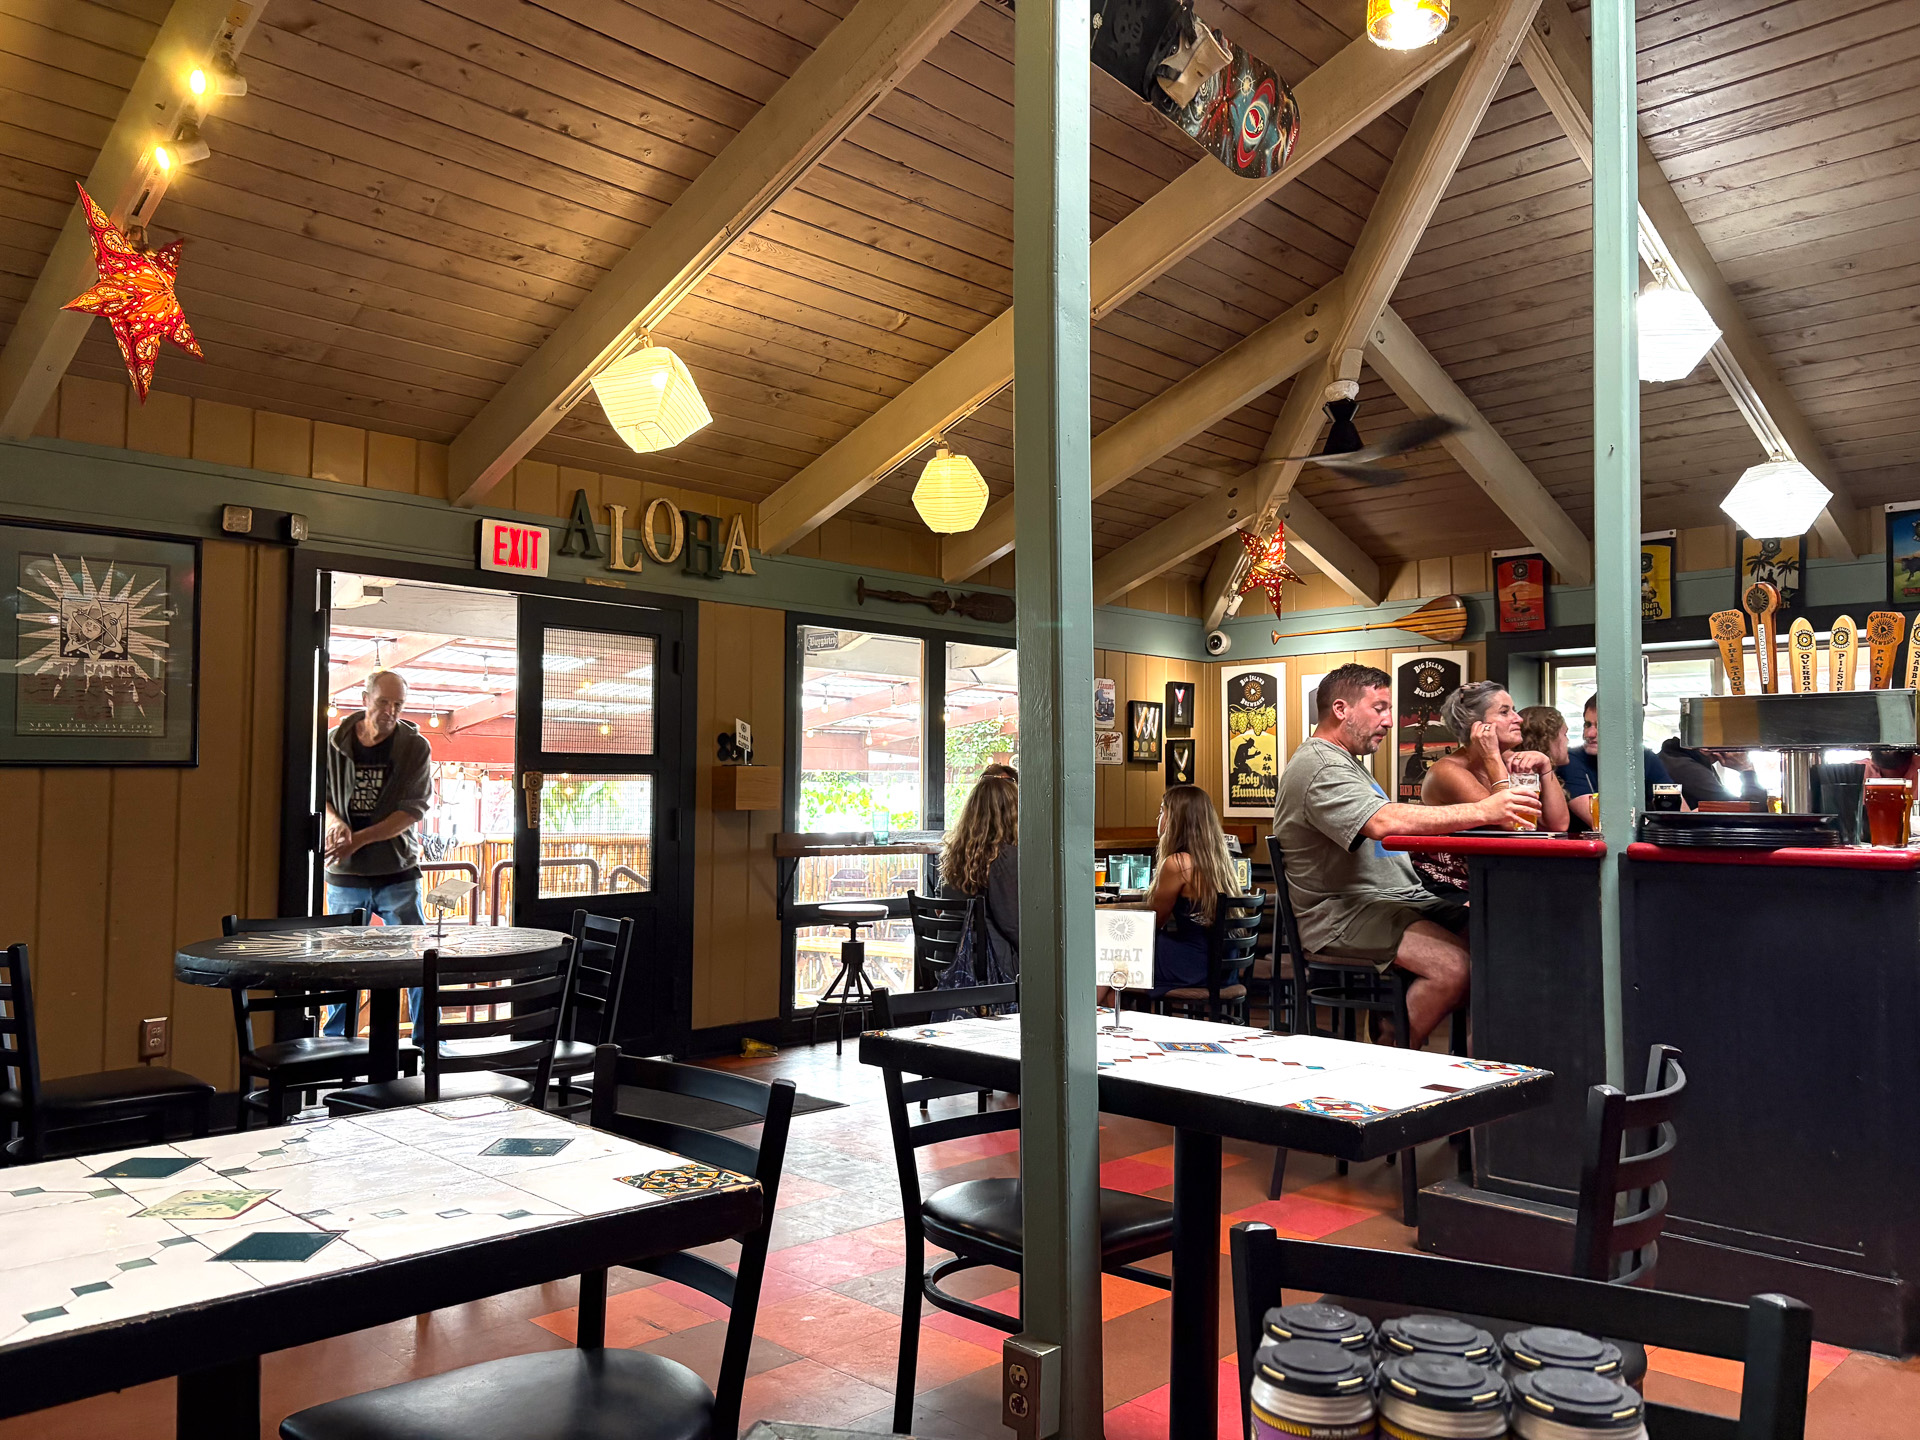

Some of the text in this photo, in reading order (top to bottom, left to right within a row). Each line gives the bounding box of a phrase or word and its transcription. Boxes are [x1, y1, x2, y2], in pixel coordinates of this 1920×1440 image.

[493, 525, 541, 570] EXIT
[558, 488, 757, 579] ALOHA
[1730, 665, 1742, 691] STOUT
[1800, 653, 1811, 691] OVERBOA
[1836, 653, 1845, 691] PILSNE
[1874, 649, 1885, 688] PANIOL
[1231, 784, 1276, 798] Humulus
[1237, 772, 1260, 787] Holy
[1399, 784, 1413, 796] RED
